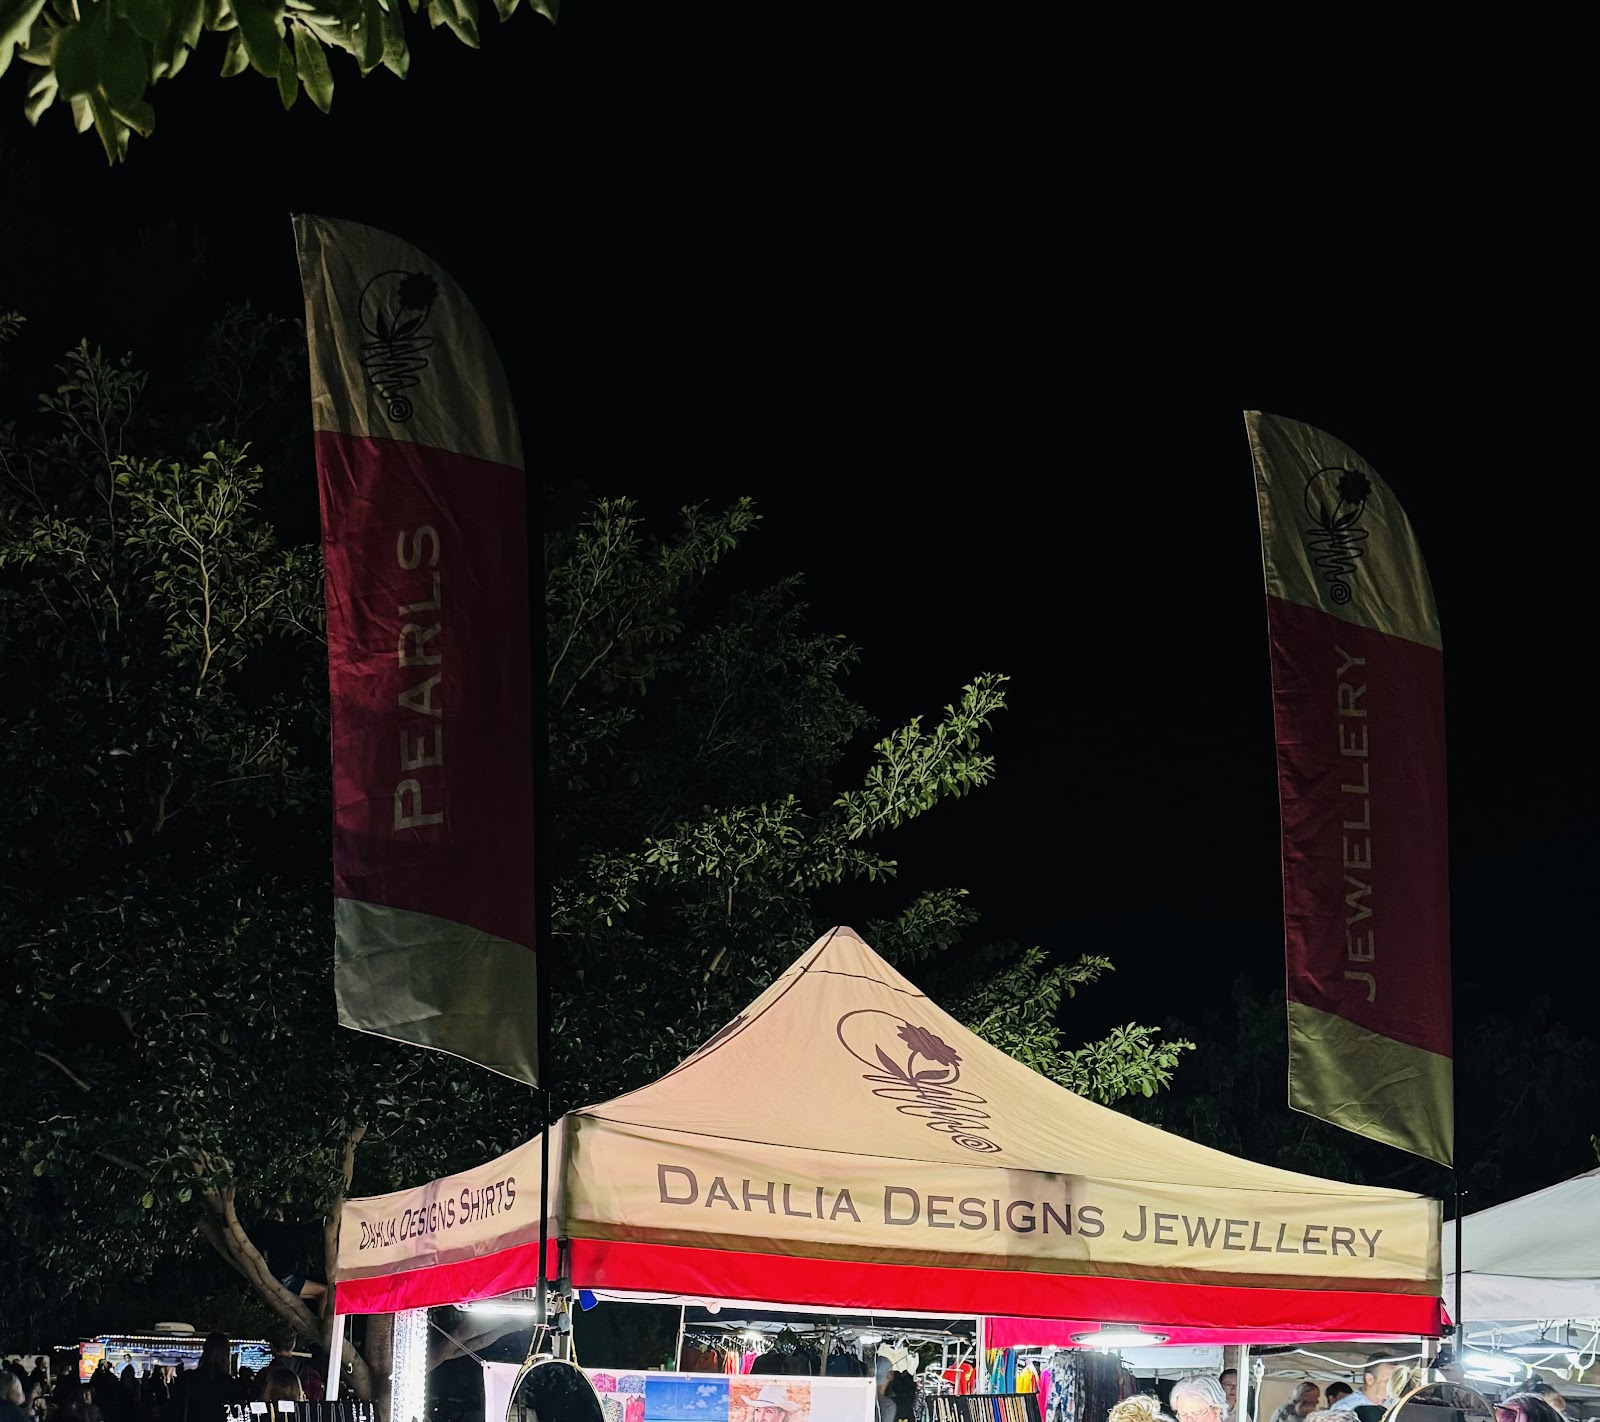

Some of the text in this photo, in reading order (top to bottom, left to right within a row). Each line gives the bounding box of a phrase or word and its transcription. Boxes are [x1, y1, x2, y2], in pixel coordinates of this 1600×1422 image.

[394, 525, 443, 831] PEARLS
[1335, 645, 1376, 1003] JEWELLERY
[359, 1176, 517, 1250] DAHLIA DESIGNS SHIRTS
[657, 1164, 1384, 1259] DAHLIA DESIGNS JEWELLERY
